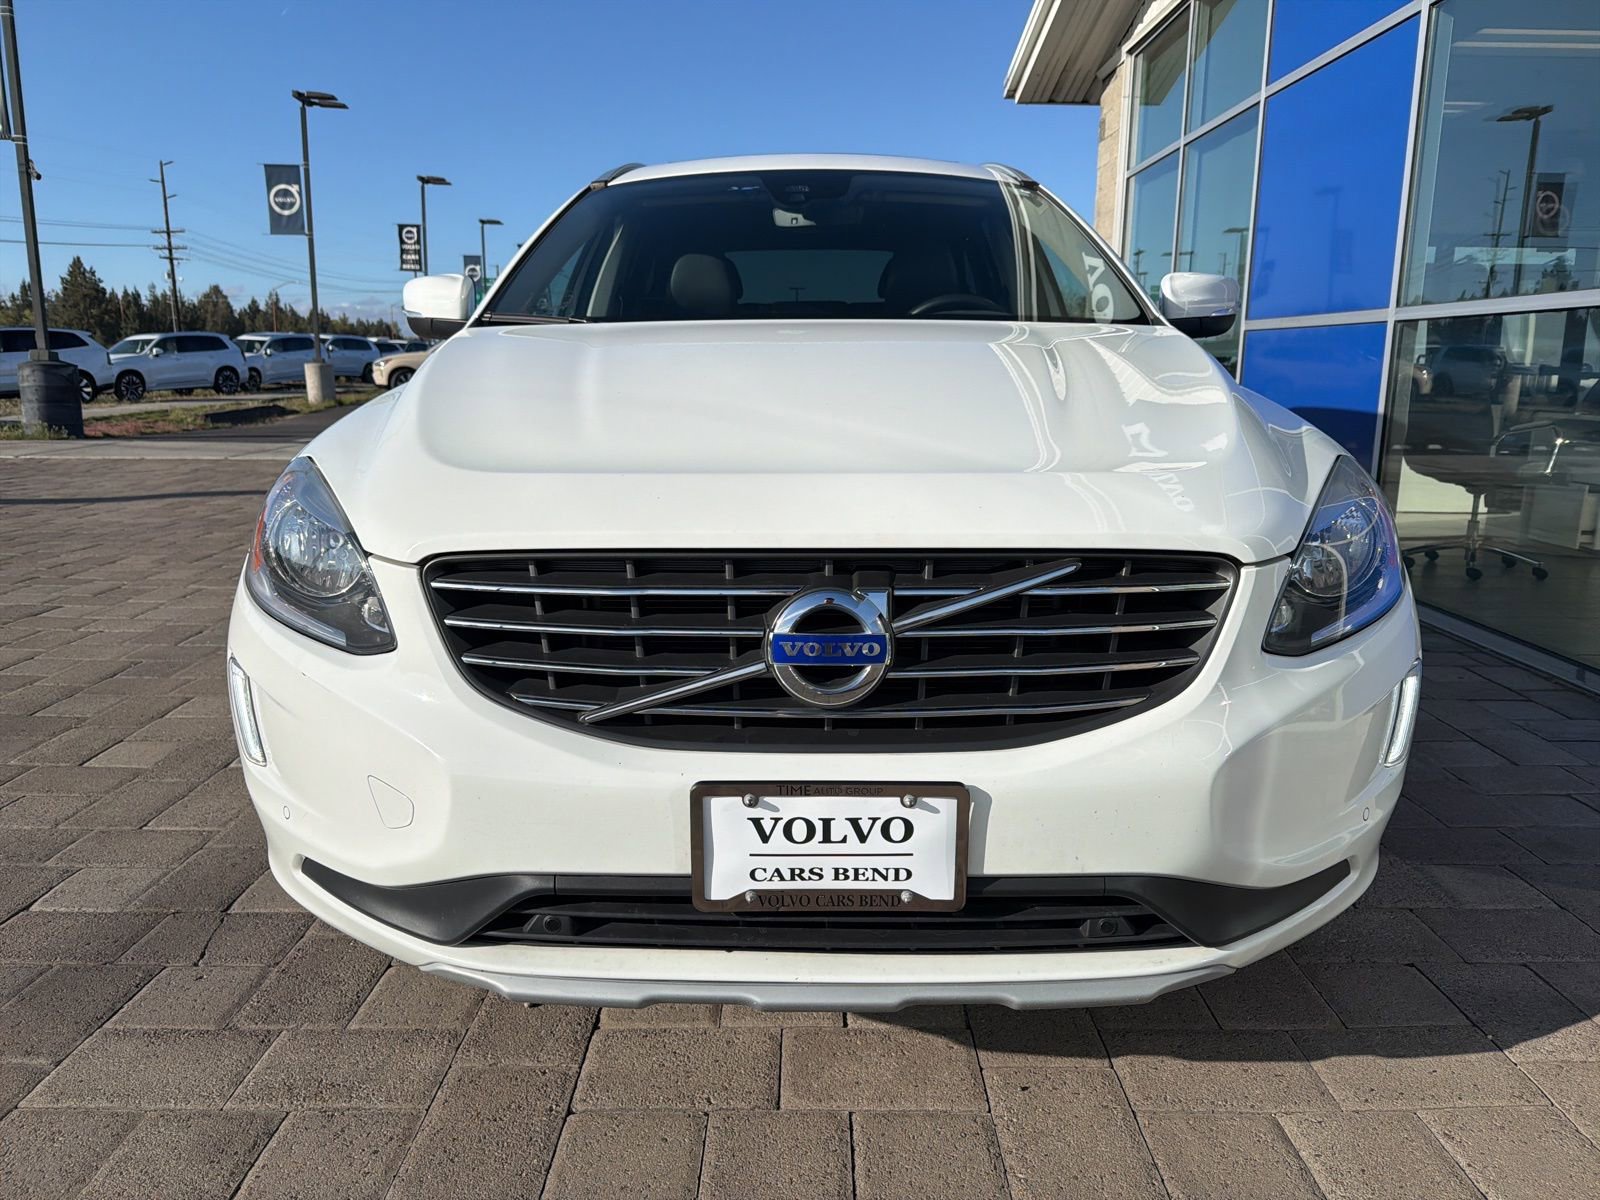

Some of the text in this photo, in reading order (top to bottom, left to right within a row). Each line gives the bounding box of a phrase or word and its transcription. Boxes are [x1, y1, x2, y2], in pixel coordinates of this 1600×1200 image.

[779, 641, 881, 657] VOLVO
[776, 785, 884, 796] TIME AUTO GROUP
[747, 816, 915, 845] VOLVO
[749, 867, 913, 882] CARS BEND
[757, 894, 901, 908] VOLVO CARS BEND
